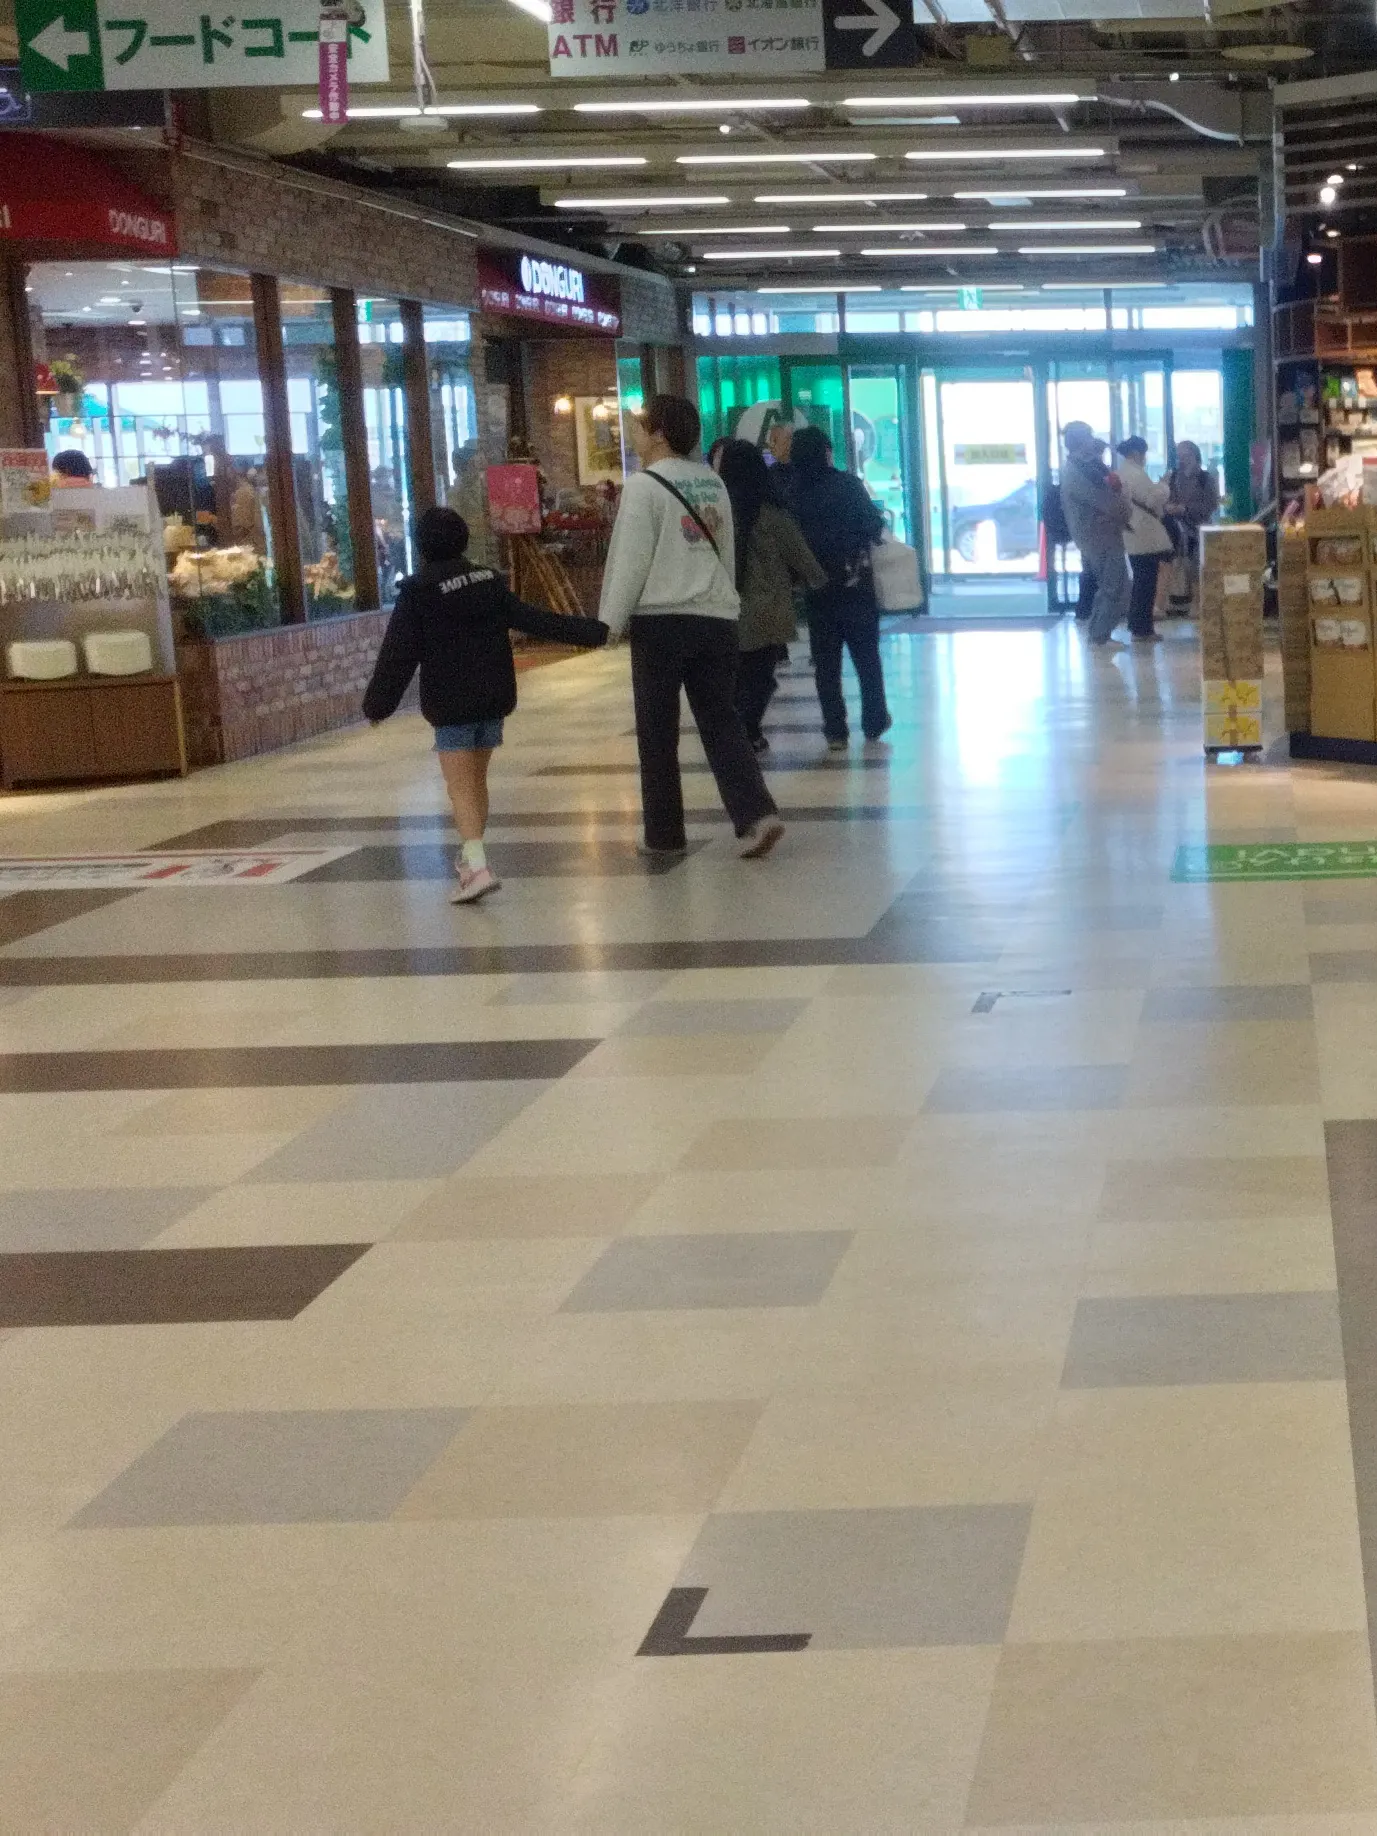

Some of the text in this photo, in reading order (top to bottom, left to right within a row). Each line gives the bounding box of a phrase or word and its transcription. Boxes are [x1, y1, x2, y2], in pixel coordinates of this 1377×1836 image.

[105, 14, 372, 65] フードコート
[551, 34, 619, 58] ATM
[746, 37, 820, 53] イオン銀行
[108, 208, 168, 244] DONGURI
[531, 258, 585, 303] DONGURI
